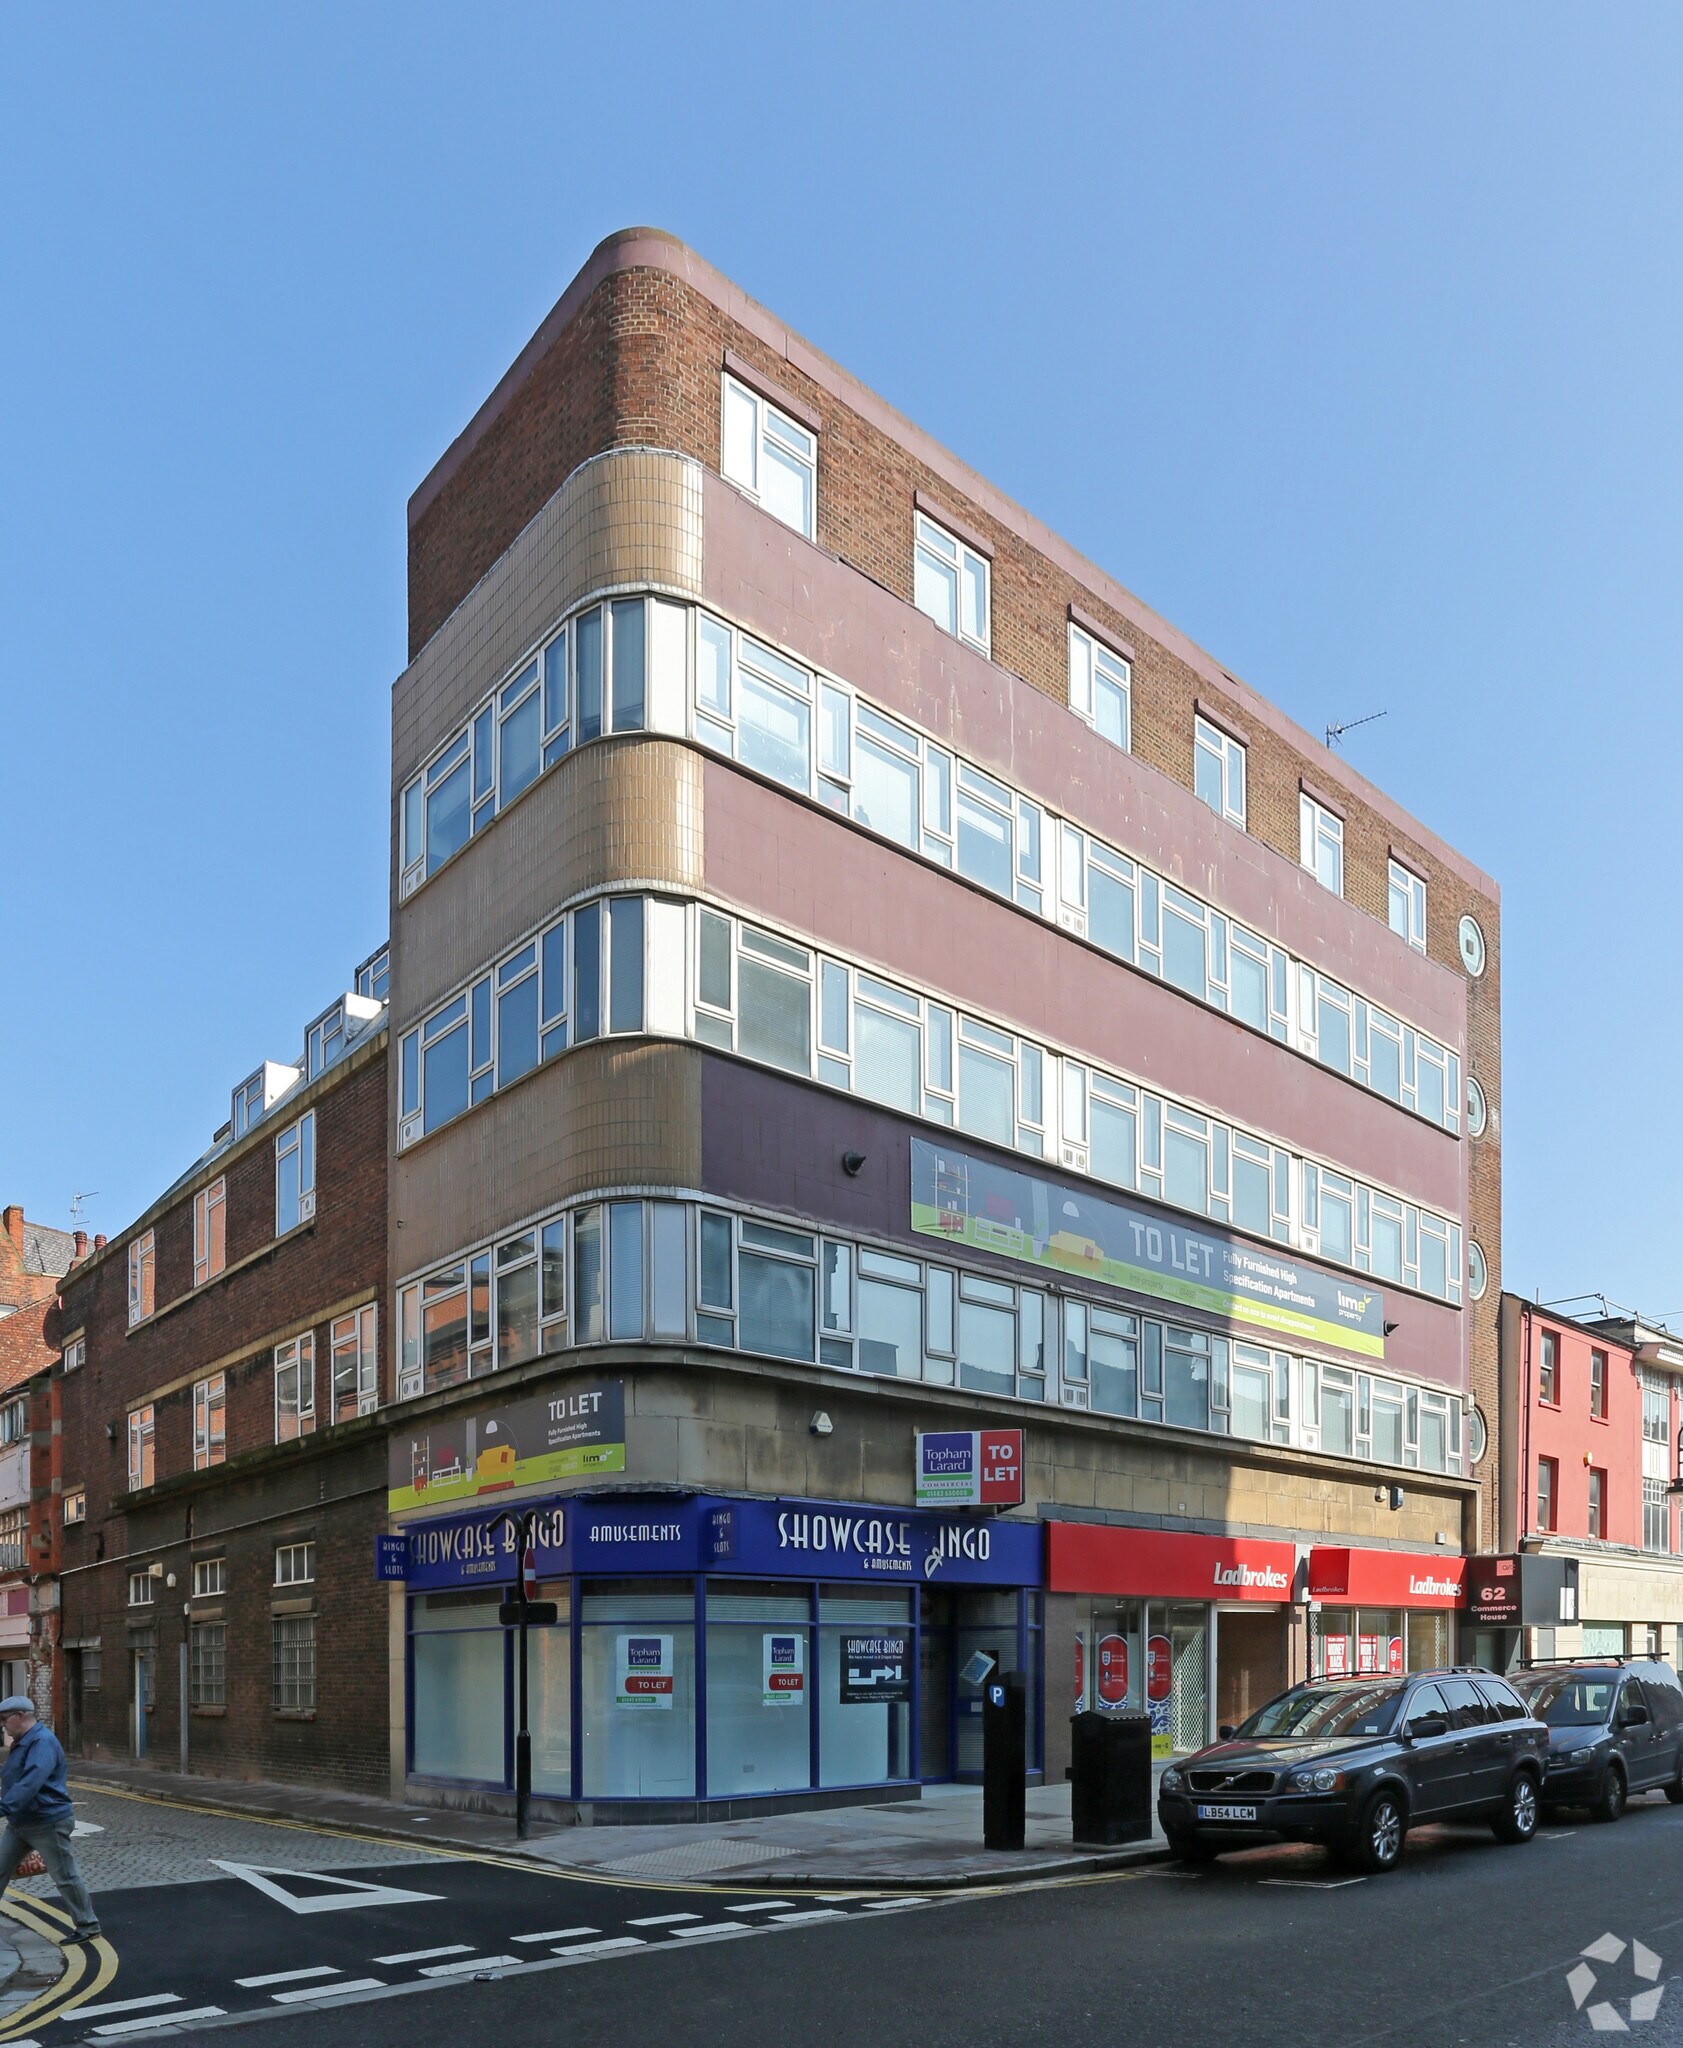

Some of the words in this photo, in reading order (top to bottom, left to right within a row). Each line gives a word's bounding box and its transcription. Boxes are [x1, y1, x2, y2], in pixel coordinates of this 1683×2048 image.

[1128, 1220, 1162, 1262] TO
[1170, 1233, 1214, 1278] LET
[1223, 1250, 1242, 1269] Fully
[1243, 1256, 1280, 1280] Furnished
[1280, 1268, 1298, 1286] High
[1223, 1270, 1273, 1296] Specification
[1273, 1285, 1316, 1308] Apartments
[1337, 1289, 1366, 1313] lime
[1338, 1310, 1363, 1322] property
[548, 1399, 565, 1421] TO
[570, 1391, 602, 1416] LET
[557, 1424, 575, 1434] Furnished
[576, 1422, 587, 1430] High
[548, 1435, 571, 1445] Specification
[572, 1430, 601, 1440] Apartments
[583, 1454, 607, 1463] lime
[925, 1448, 971, 1462] Topham
[988, 1444, 1013, 1459] TO
[930, 1459, 966, 1471] Larard
[984, 1466, 1018, 1482] LET
[712, 1512, 731, 1526] BINGO
[409, 1523, 495, 1566] SHOWCASE
[502, 1510, 564, 1553] BNGO
[589, 1525, 681, 1542] AMUSEMENTS
[778, 1513, 911, 1555] SHOWCASE
[383, 1542, 405, 1552] BINGO
[713, 1541, 730, 1553] SLOTS
[385, 1565, 404, 1575] SLOTS
[871, 1558, 912, 1571] AMUSEMENTS
[1213, 1561, 1288, 1589] Ladbrokes
[1409, 1574, 1463, 1597] Ladbrokes
[1481, 1586, 1506, 1601] 62
[1471, 1604, 1517, 1612] Commerce
[630, 1648, 661, 1657] Topham
[772, 1647, 795, 1655] Topham
[847, 1639, 881, 1654] SHOWCASE
[883, 1639, 904, 1654] BINGO
[633, 1656, 657, 1664] Larard
[638, 1681, 650, 1689] TO
[651, 1681, 667, 1689] LET
[778, 1678, 787, 1686] TO
[787, 1678, 799, 1686] LET
[993, 1687, 1003, 1703] P
[1204, 1807, 1230, 1818] LB54
[1232, 1807, 1255, 1819] LCM
